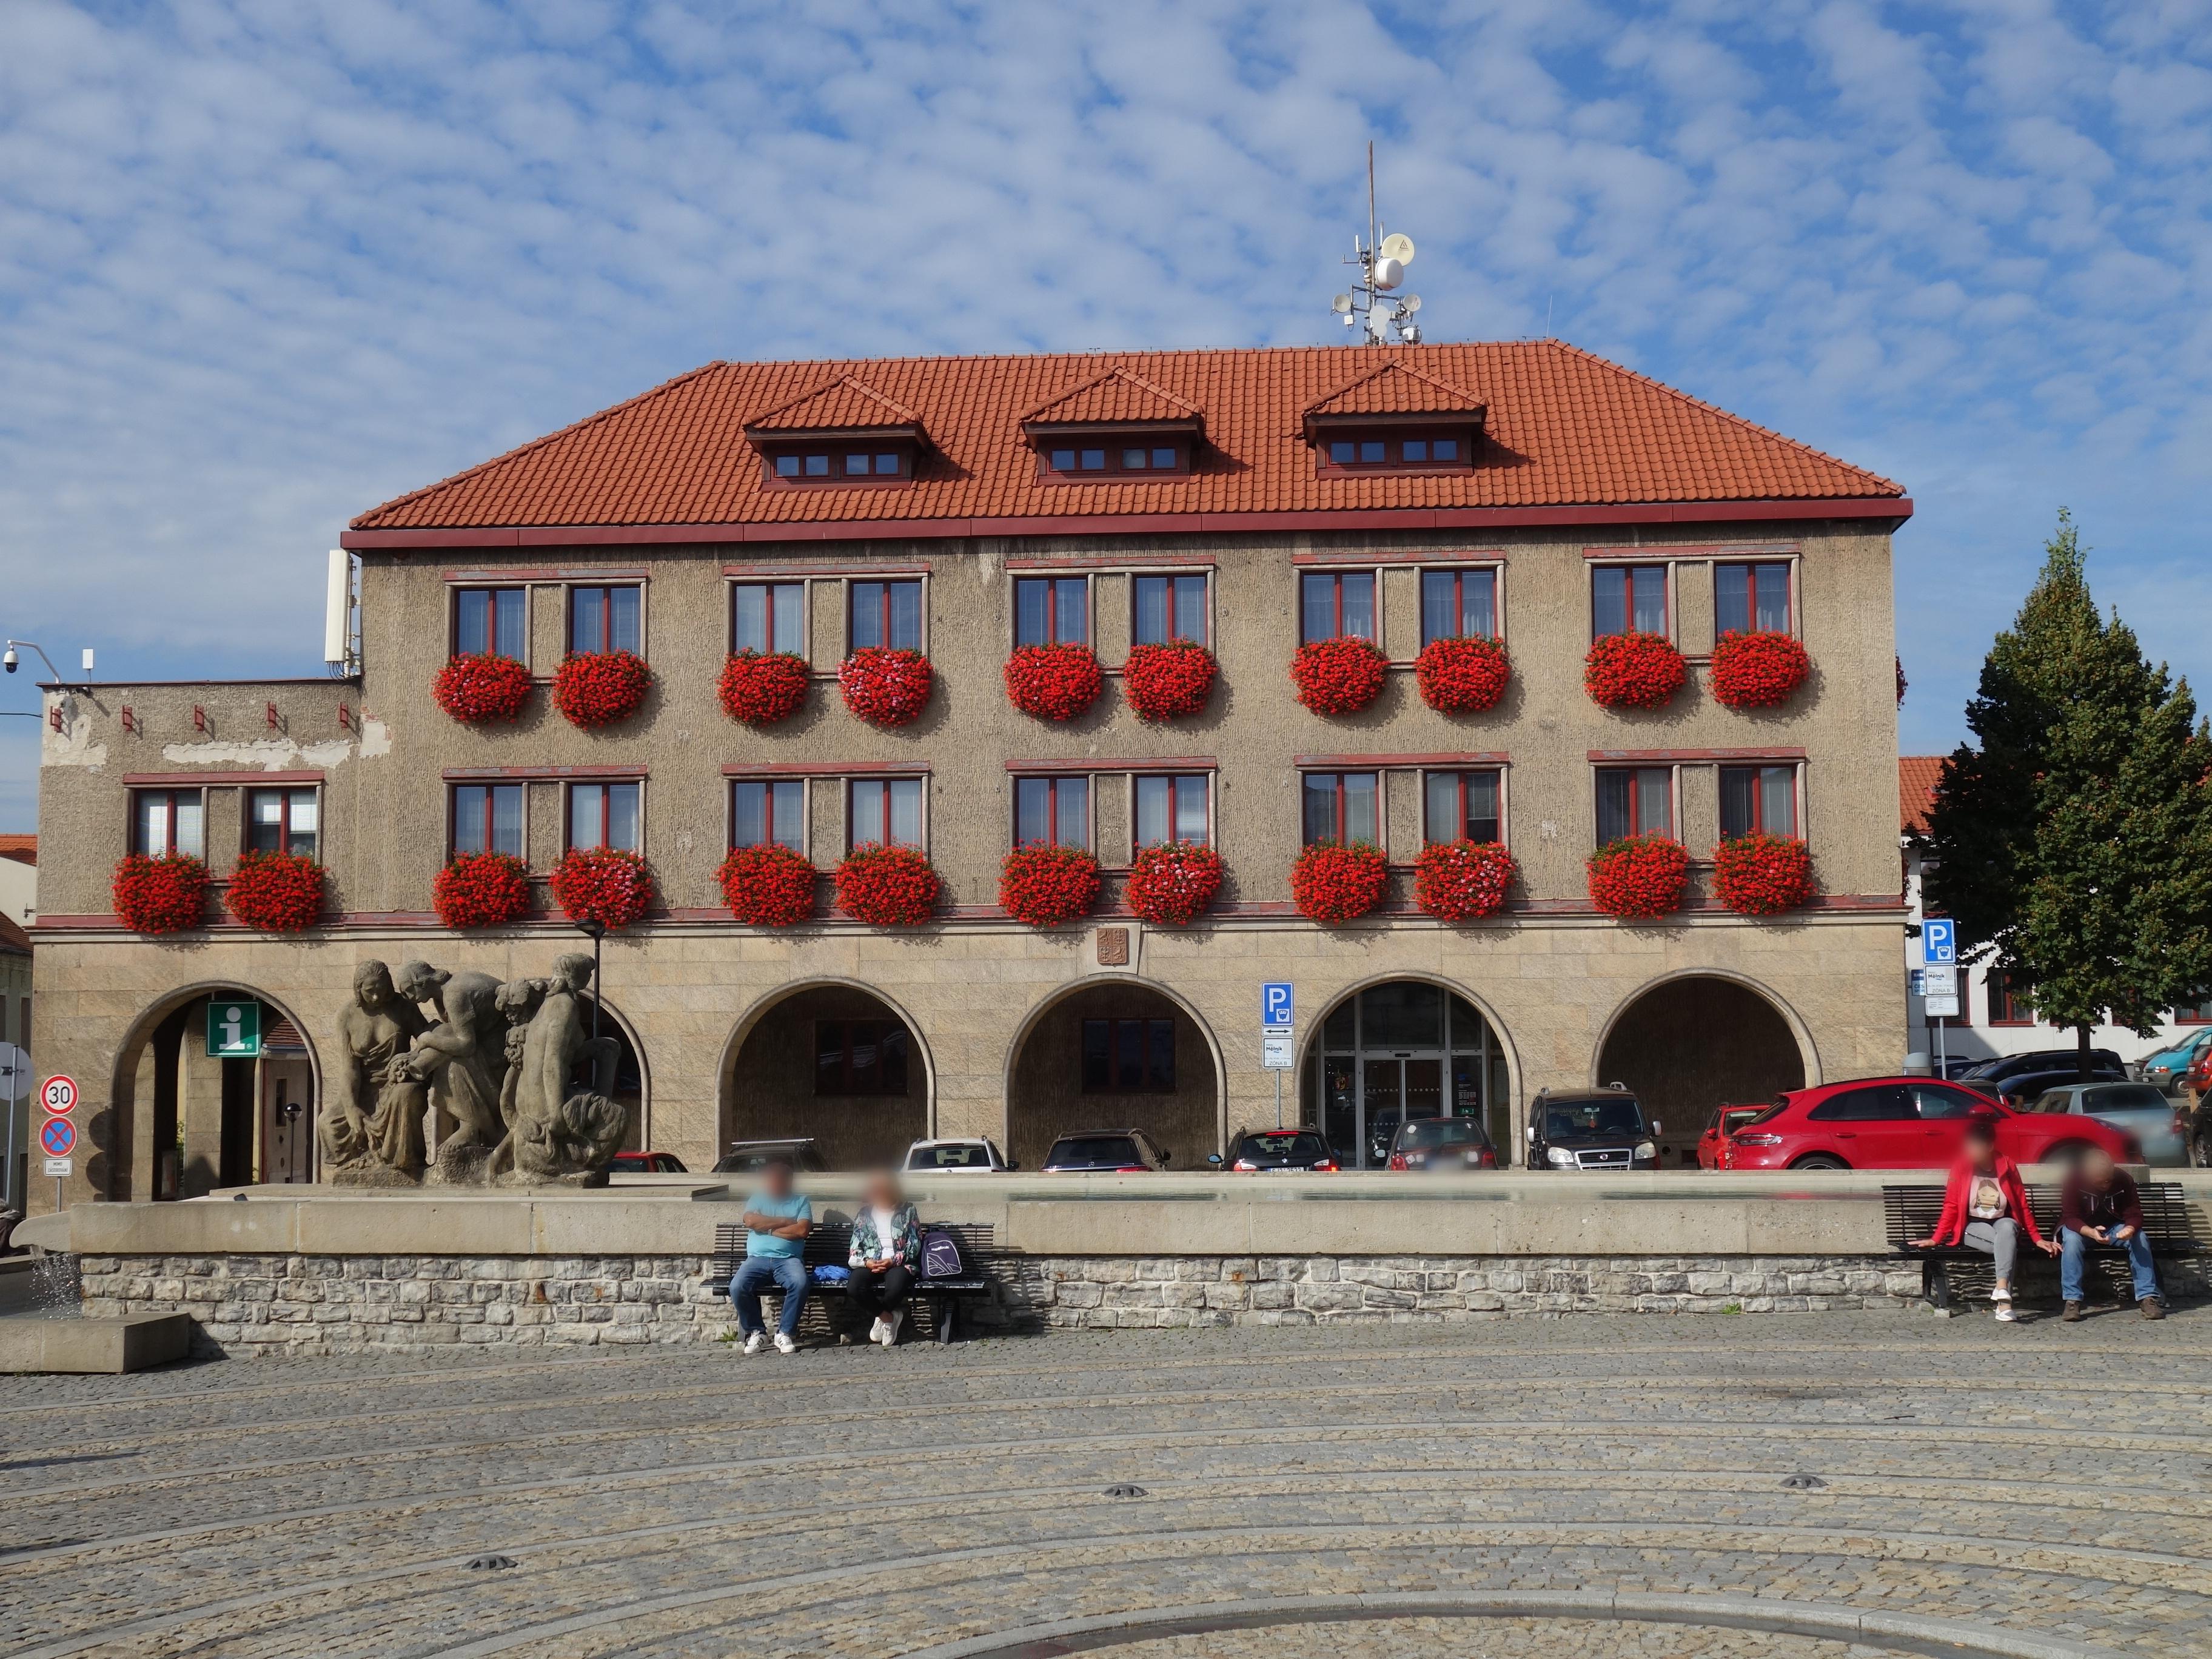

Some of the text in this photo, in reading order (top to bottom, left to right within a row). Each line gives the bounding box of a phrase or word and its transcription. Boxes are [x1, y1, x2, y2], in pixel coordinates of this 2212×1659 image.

[1929, 925, 1947, 950] P
[1269, 988, 1287, 1012] P
[49, 1086, 70, 1104] 30
